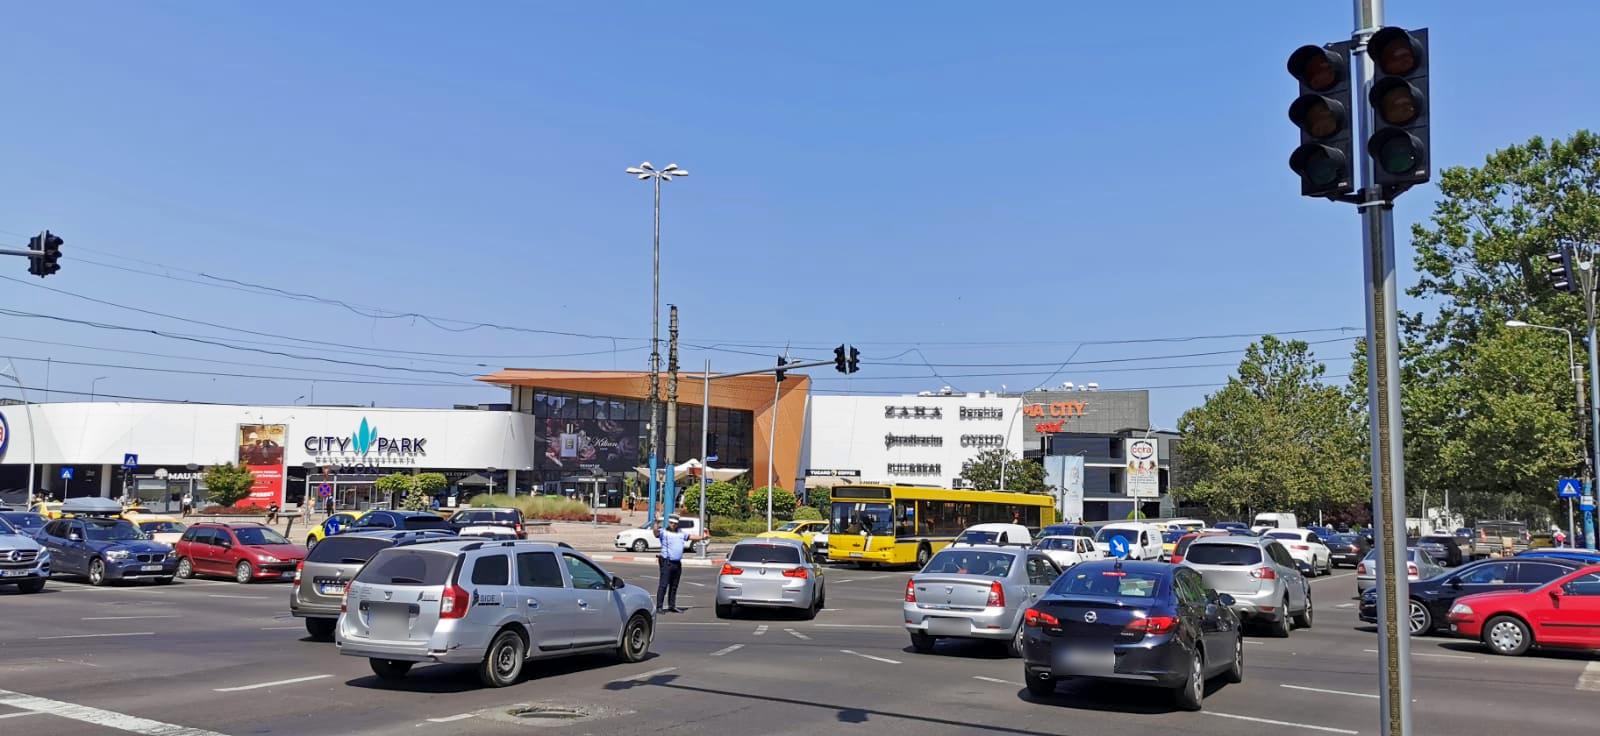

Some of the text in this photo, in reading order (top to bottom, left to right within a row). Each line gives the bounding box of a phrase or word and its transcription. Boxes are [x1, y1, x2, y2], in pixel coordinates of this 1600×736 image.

[1049, 400, 1087, 417] CITY
[304, 436, 427, 455] CITY PARK
